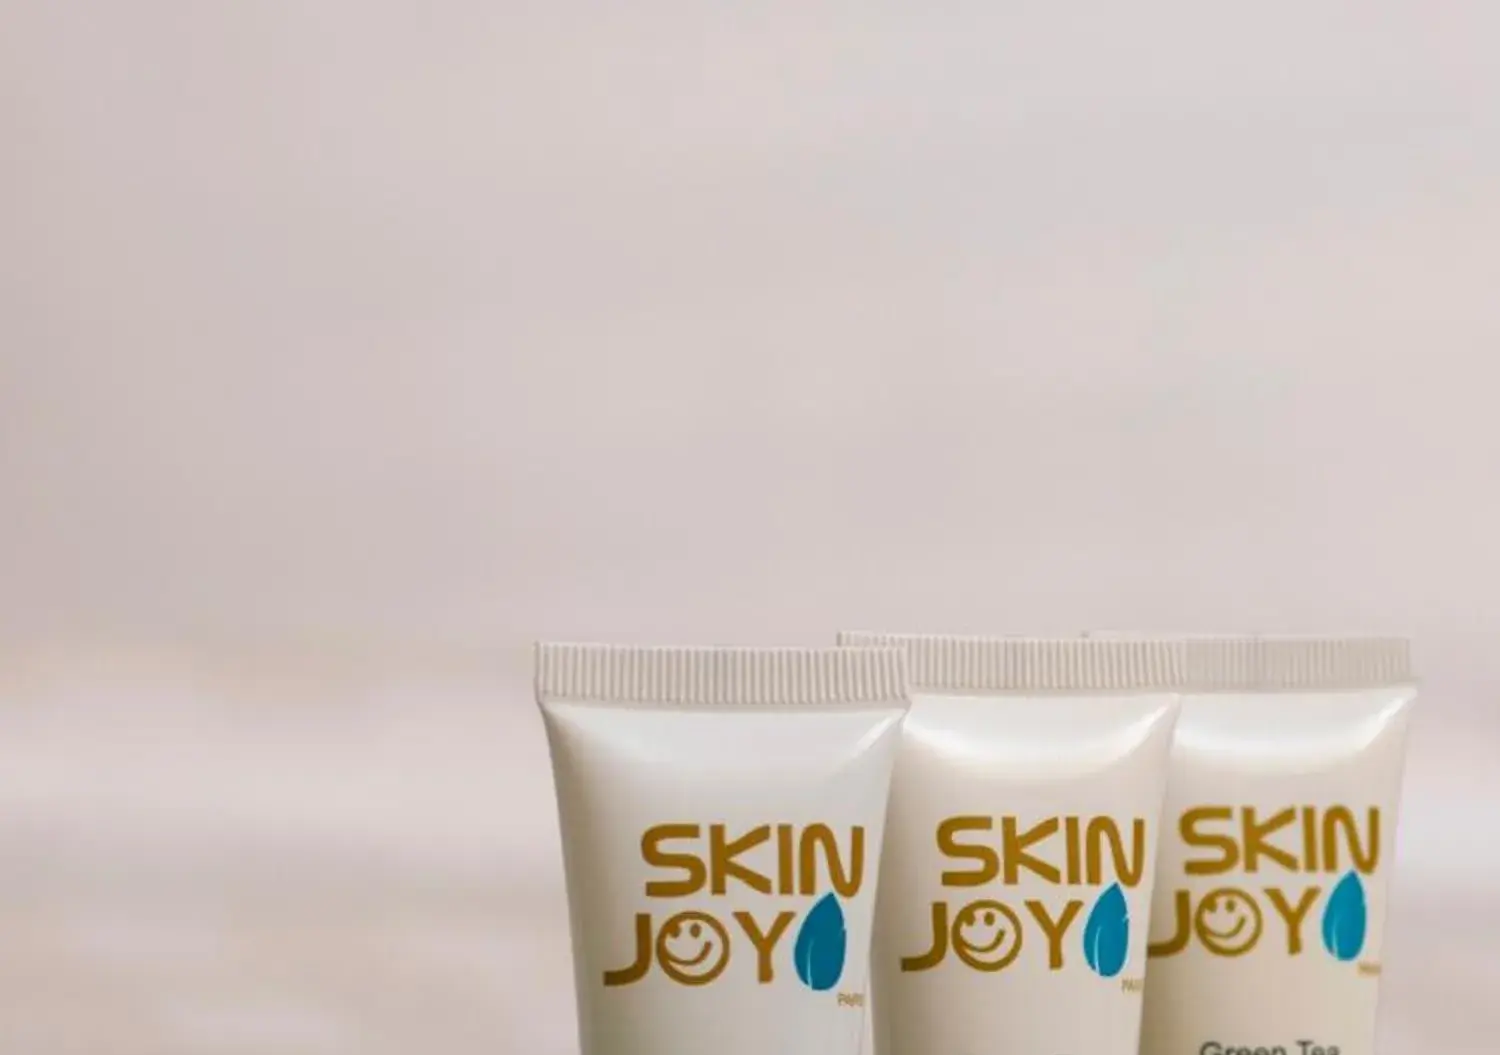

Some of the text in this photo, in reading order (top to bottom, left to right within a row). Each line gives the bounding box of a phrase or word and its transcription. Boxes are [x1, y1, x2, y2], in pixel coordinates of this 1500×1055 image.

[640, 823, 865, 898] SKIN
[936, 815, 1145, 888] SKIN
[1179, 805, 1380, 875] SKIN
[603, 911, 797, 986] JOY
[900, 899, 1084, 973] JOY
[1147, 887, 1322, 958] JOY
